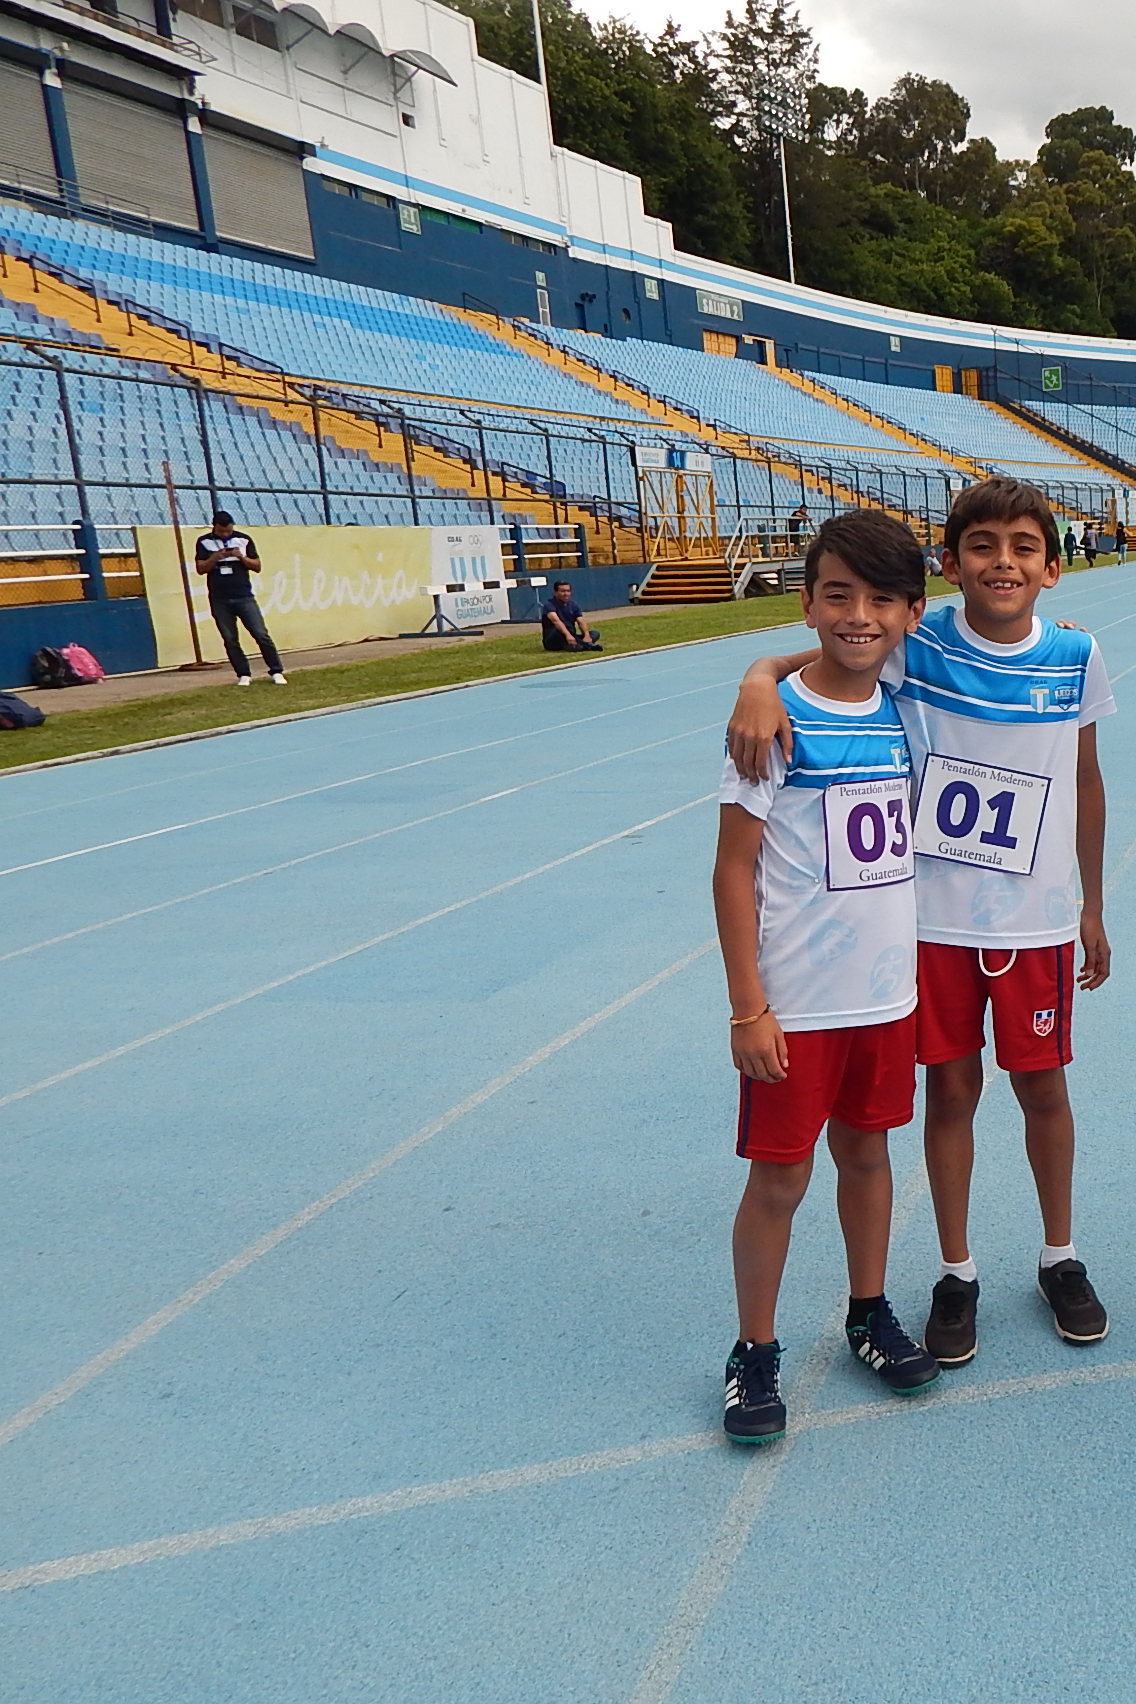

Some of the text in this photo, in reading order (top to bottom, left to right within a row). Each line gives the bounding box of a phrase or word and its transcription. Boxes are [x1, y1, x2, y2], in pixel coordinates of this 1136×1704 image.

[702, 298, 732, 317] SALIDA
[732, 305, 739, 319] 2
[456, 605, 495, 619] GUATEMALA
[941, 759, 1034, 789] Pentatlón Moderno
[839, 783, 883, 797] Pentatlón
[936, 780, 1018, 850] 01
[846, 798, 908, 863] 03
[938, 841, 1003, 866] Guatemala
[858, 862, 908, 882] Guatemala
